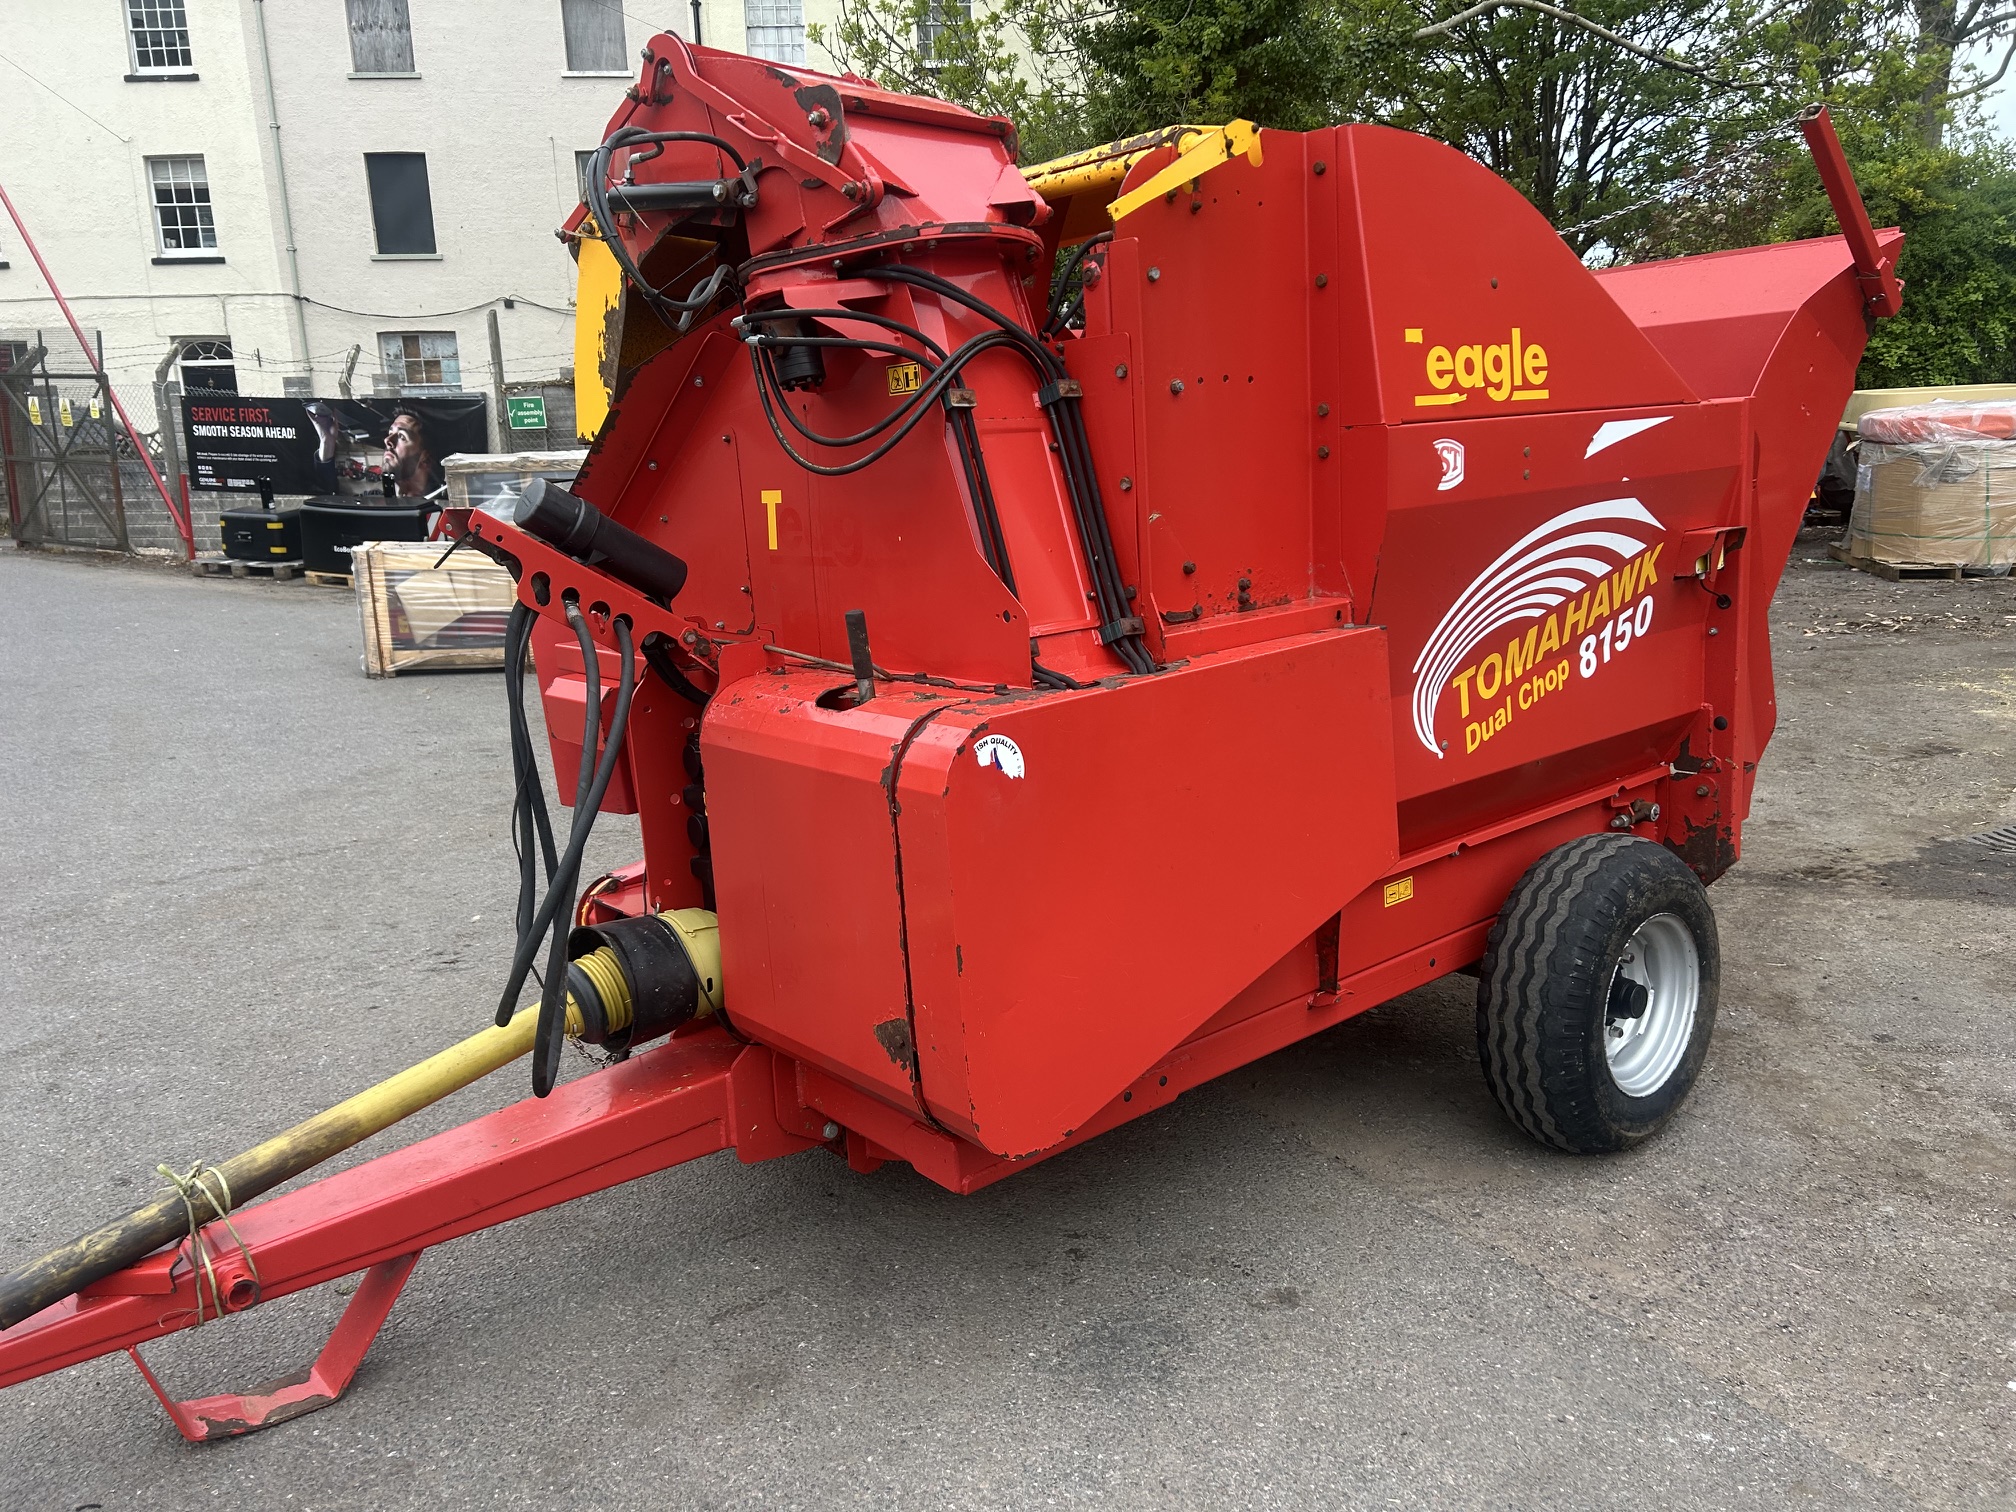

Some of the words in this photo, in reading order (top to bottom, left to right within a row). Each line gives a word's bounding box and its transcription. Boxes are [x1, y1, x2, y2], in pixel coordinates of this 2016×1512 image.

[1405, 328, 1548, 402] eagle
[191, 407, 236, 422] SERVICE
[239, 408, 272, 425] FIRST,
[192, 425, 228, 436] SMOOTH
[229, 426, 264, 438] SEASON
[265, 427, 296, 438] AHEAD!
[1452, 542, 1664, 719] TOMAHAWK
[1465, 695, 1513, 755] Dual
[1518, 659, 1570, 710] Chop
[1579, 595, 1654, 679] 8150
[990, 737, 1018, 755] QUALITY
